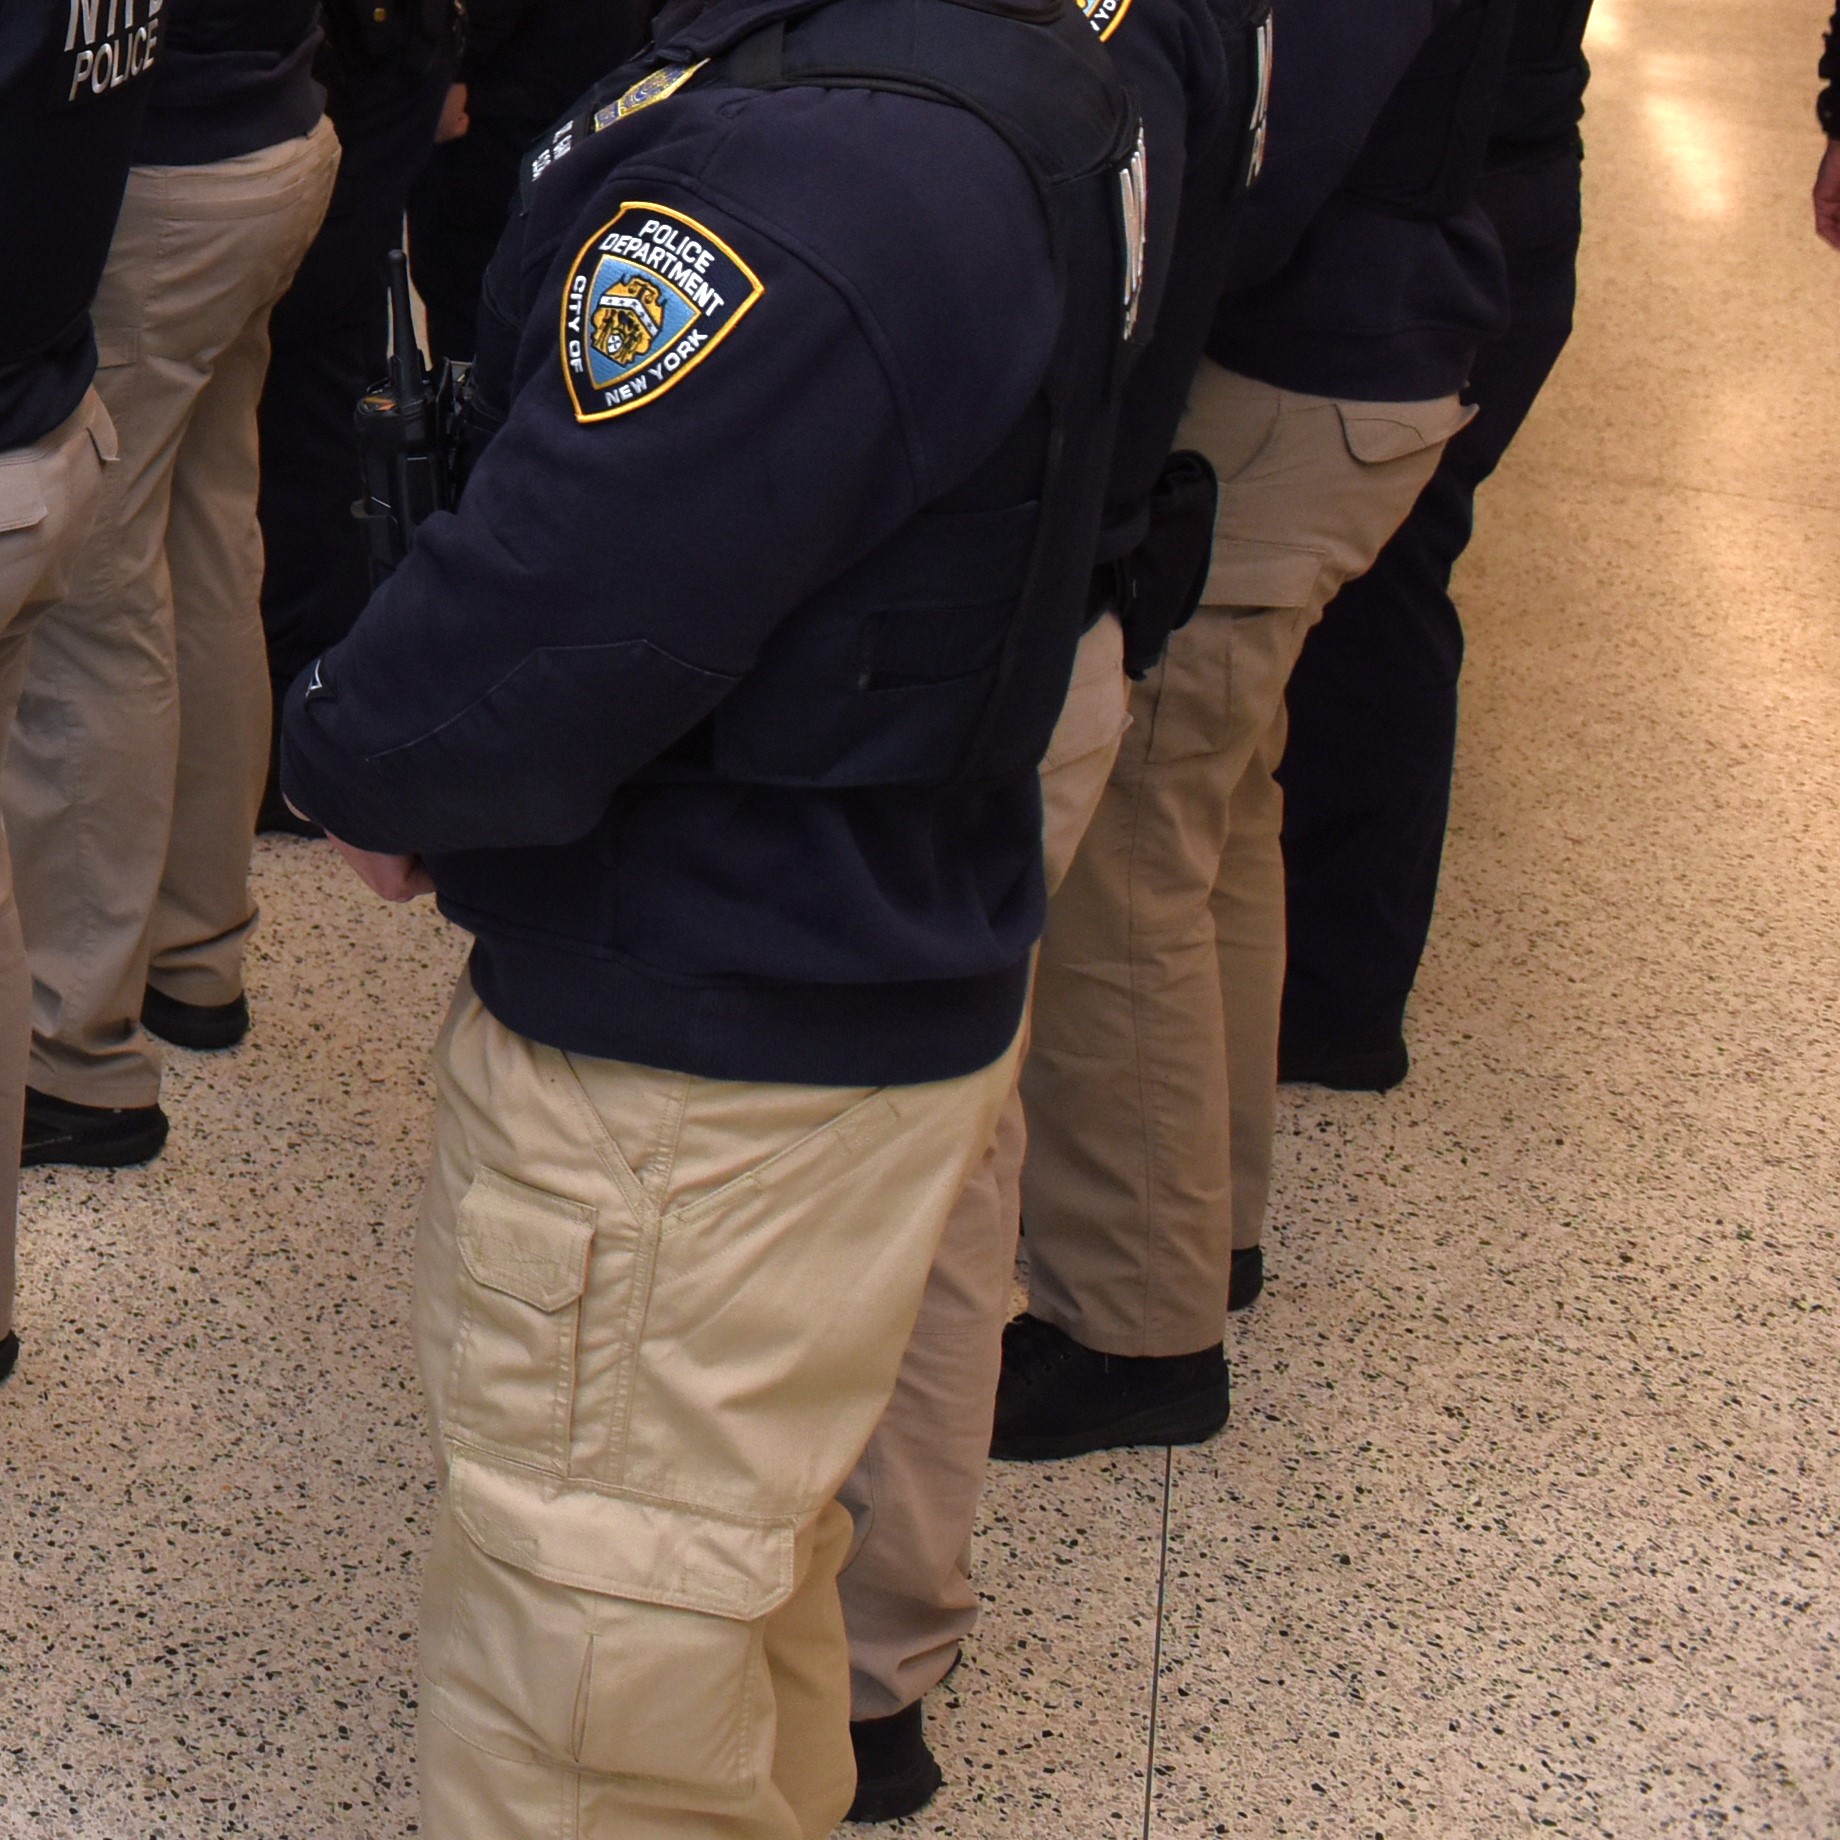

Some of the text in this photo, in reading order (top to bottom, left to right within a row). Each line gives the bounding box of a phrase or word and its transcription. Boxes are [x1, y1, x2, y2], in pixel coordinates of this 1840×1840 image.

[68, 17, 159, 102] POLICE
[598, 232, 725, 318] DEPARTMENT
[638, 219, 715, 274] POLICE
[567, 275, 587, 373] CITY OF
[605, 328, 709, 407] NEW YORK
